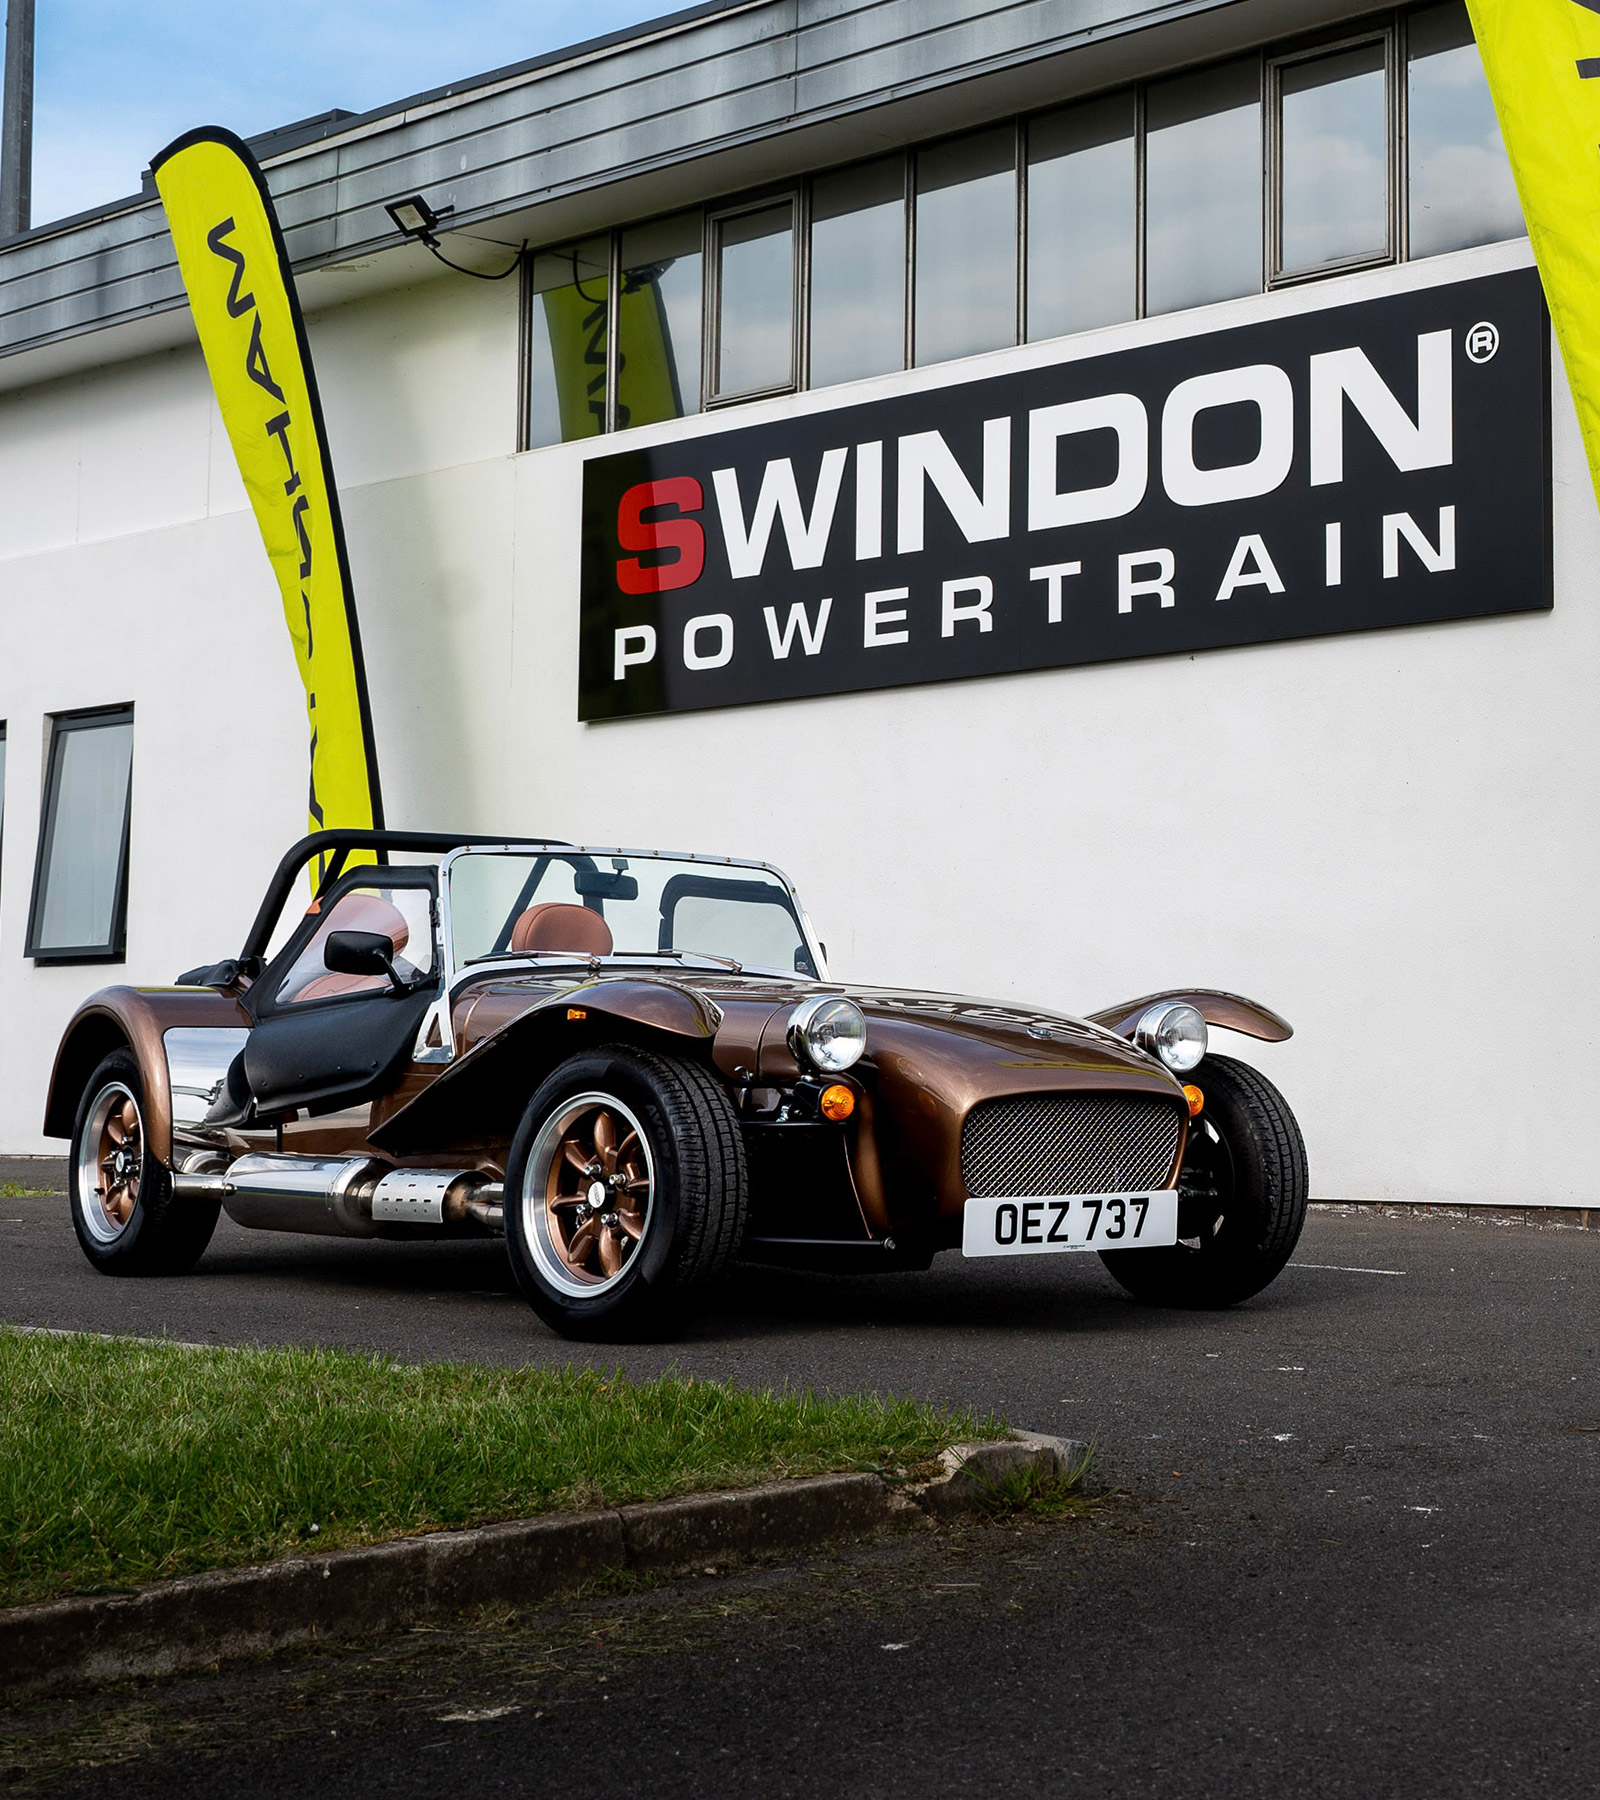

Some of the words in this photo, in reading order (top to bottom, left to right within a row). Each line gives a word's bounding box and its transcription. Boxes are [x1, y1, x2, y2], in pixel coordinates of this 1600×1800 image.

[613, 505, 1456, 681] POWERTRAIN
[995, 1201, 1070, 1245] OEZ
[1082, 1197, 1150, 1241] 737
